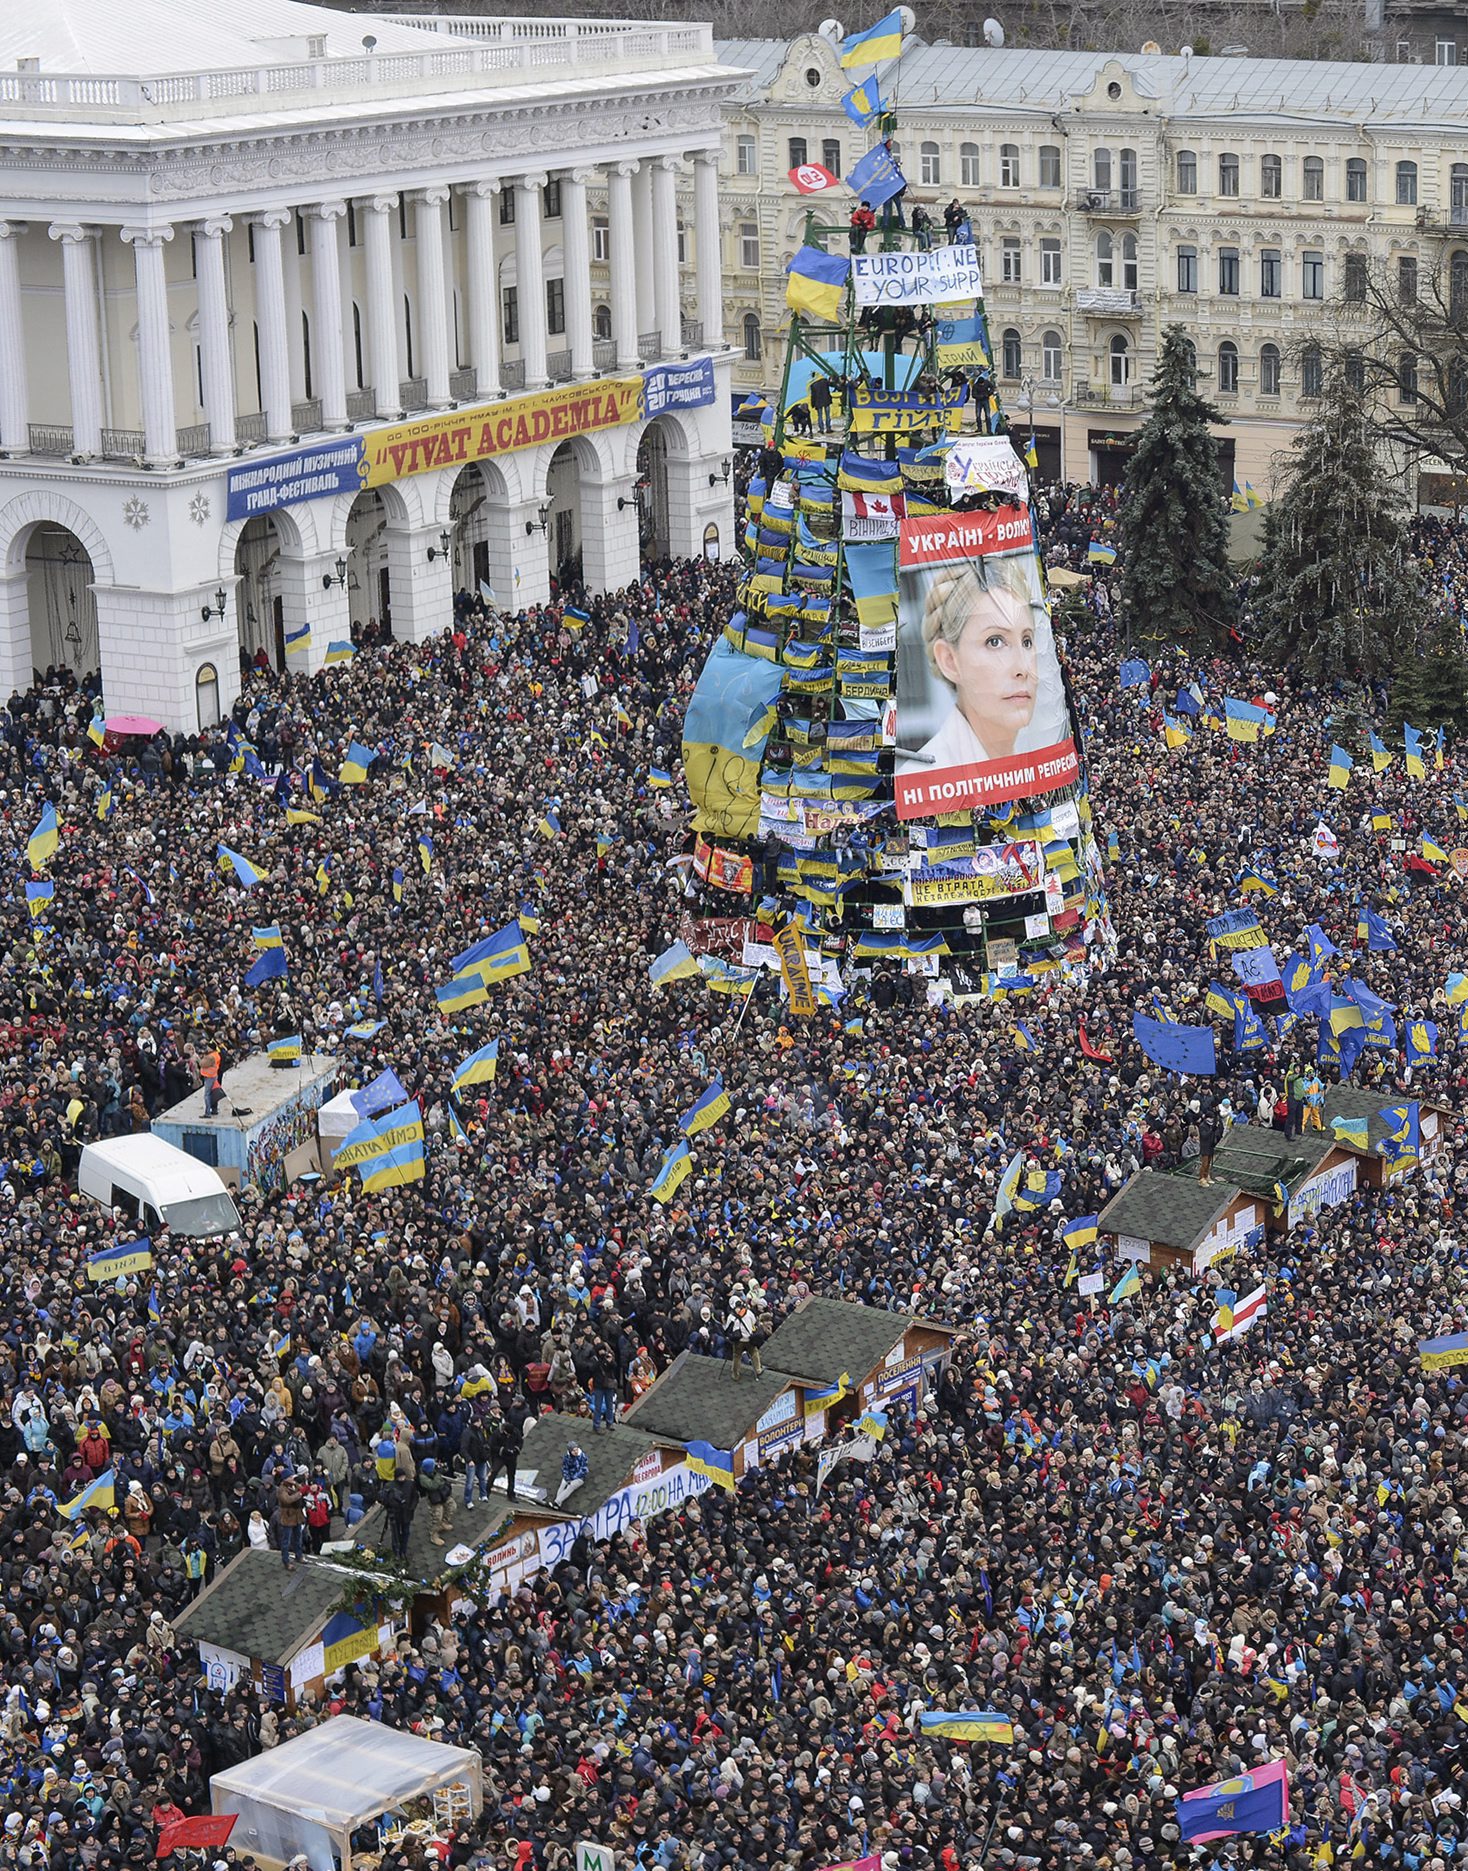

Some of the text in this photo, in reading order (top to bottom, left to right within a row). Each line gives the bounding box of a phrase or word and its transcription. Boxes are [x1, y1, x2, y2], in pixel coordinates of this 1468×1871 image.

[872, 275, 933, 303] YOUR
[541, 381, 624, 407] ЧАЙКОВСЬКОГО
[647, 373, 665, 393] 20
[668, 369, 703, 386] ВЕРЕСНЯ
[648, 390, 665, 411] 20
[666, 386, 702, 403] ГРУДНЯ
[230, 445, 358, 493] МІЖНАРОДНИЙ МУЗИЧНИЙ
[246, 472, 339, 511] ГРАНД-ФЕСТИВАЛЬ
[908, 528, 983, 554] УКРАЇНІ
[903, 788, 924, 806] НІ
[929, 767, 1036, 801] ПОЛІТИЧНИМ
[915, 879, 985, 896] ЦЕ ВТРАТА
[777, 928, 812, 1009] UKRAINE
[878, 1356, 921, 1383] ПОСЕЛЕННЯ
[759, 1418, 805, 1447] ВОЛОНТЕРИ
[636, 1486, 666, 1518] 12:00
[668, 1473, 685, 1506] НА
[487, 1546, 518, 1567] ВОЛИНЬ
